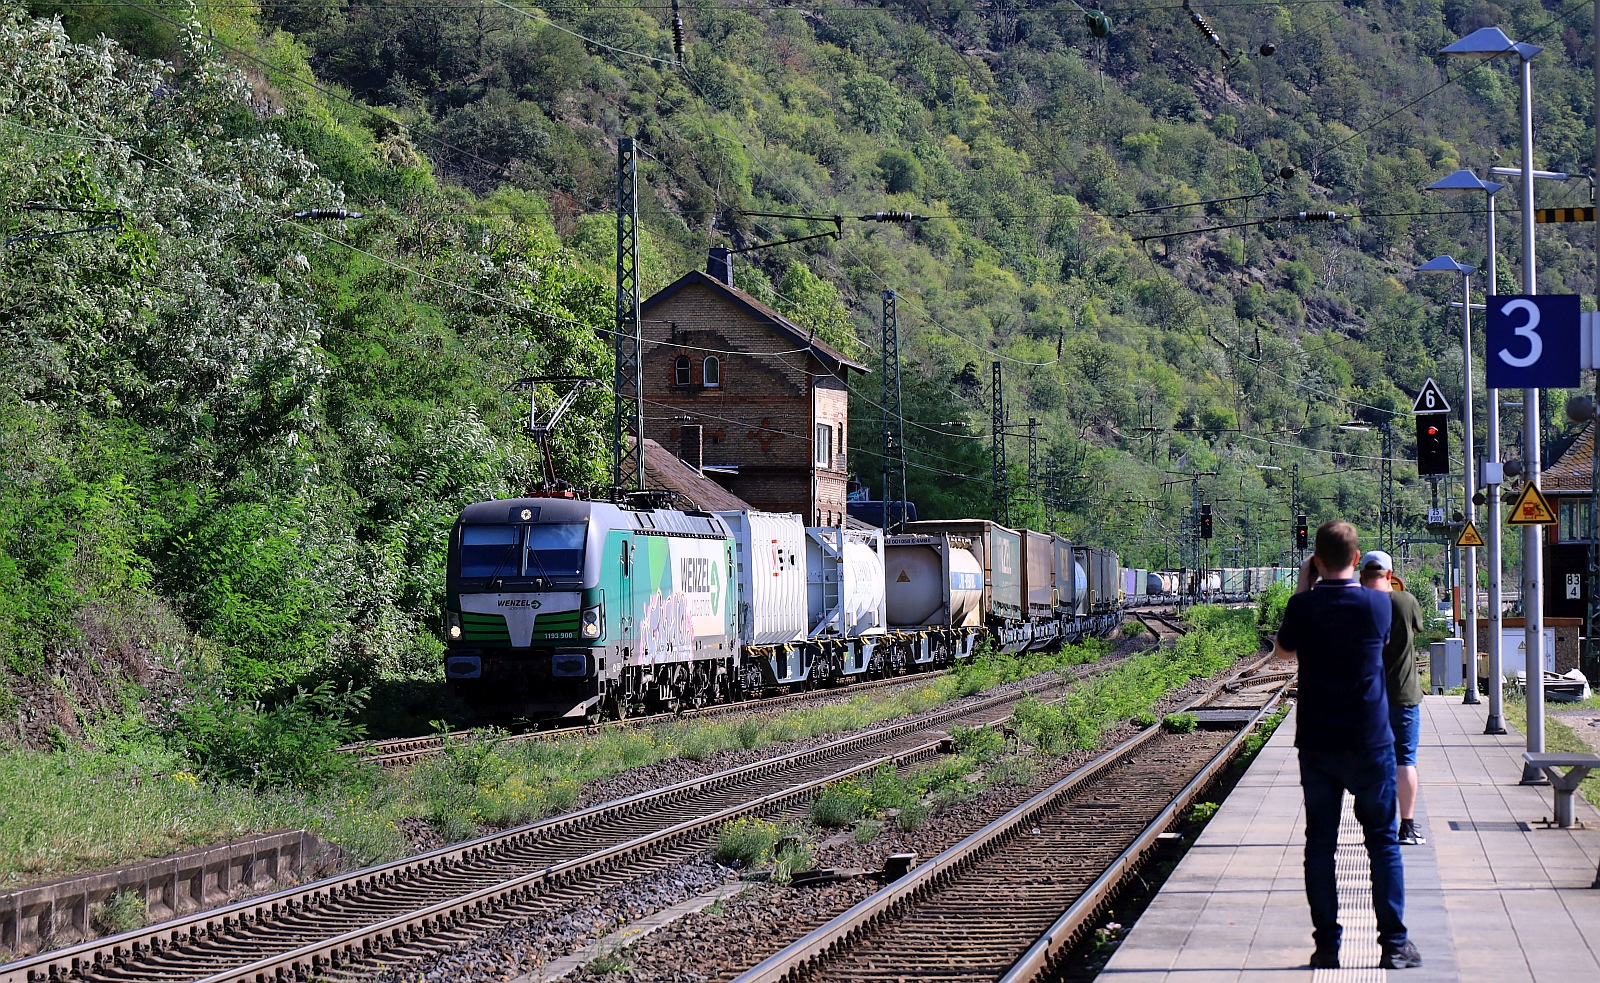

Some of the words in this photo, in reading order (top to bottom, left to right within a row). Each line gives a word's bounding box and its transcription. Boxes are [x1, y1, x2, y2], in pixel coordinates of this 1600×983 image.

[1497, 298, 1543, 368] 3
[1425, 389, 1436, 409] 6
[1432, 508, 1440, 516] 25
[680, 557, 710, 593] WENZEL
[1567, 575, 1580, 586] 83
[1570, 586, 1578, 597] 4
